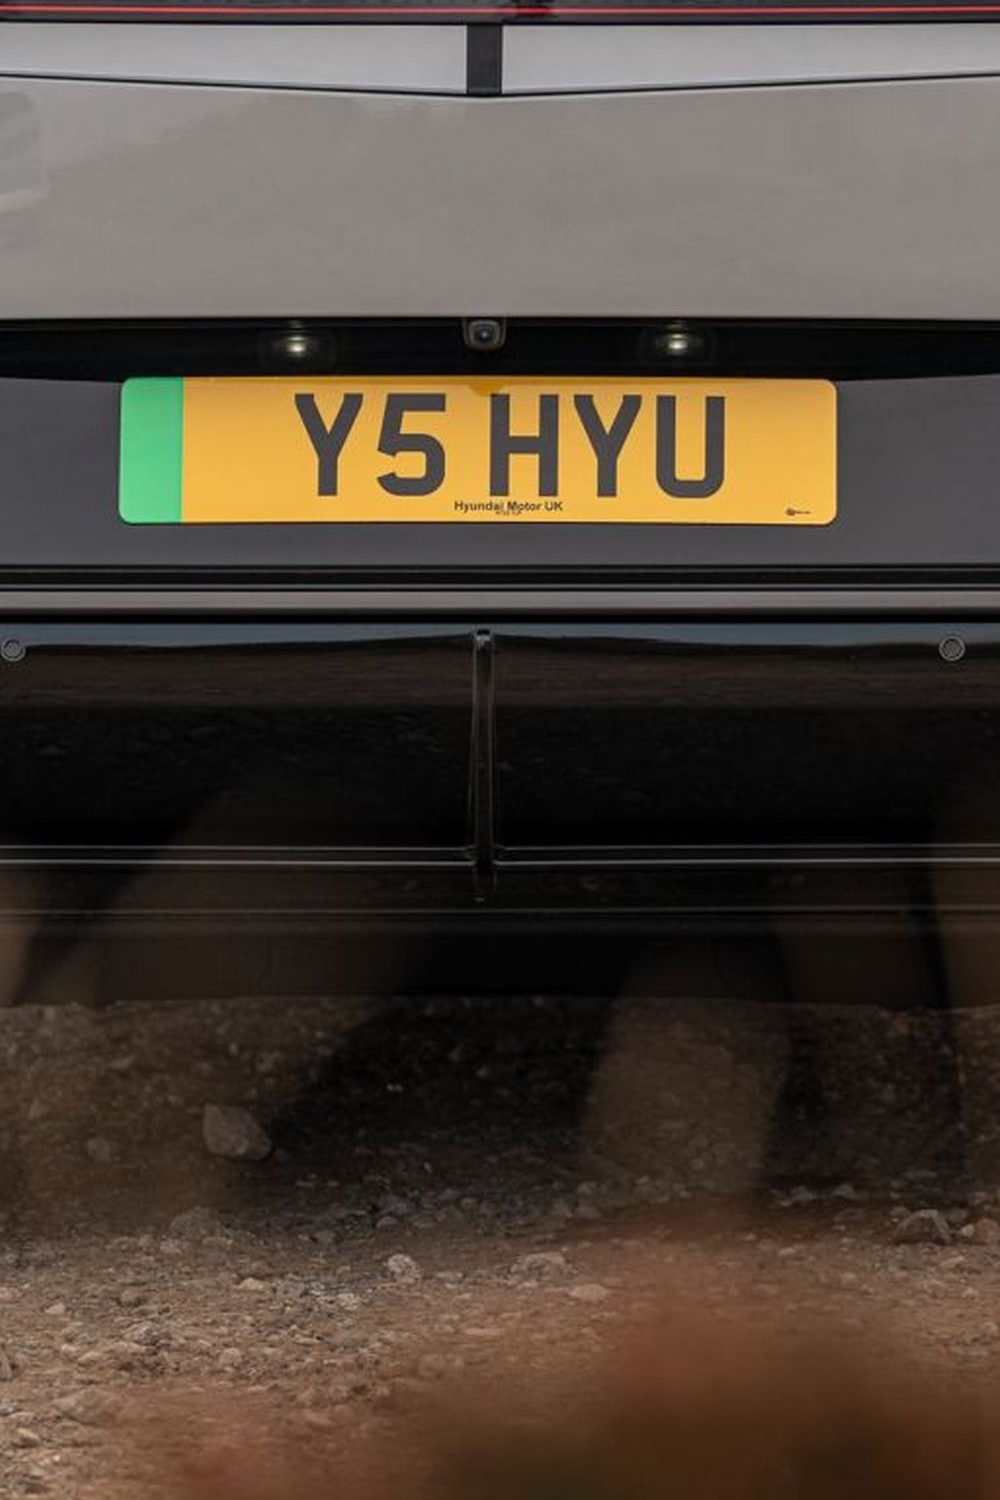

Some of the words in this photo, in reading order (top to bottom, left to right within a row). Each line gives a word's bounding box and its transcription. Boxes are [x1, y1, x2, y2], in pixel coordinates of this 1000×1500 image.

[294, 392, 447, 497] Y5
[488, 391, 726, 499] HYU
[454, 501, 504, 513] Hyundai
[507, 501, 542, 511] Motor
[544, 501, 563, 511] UK
